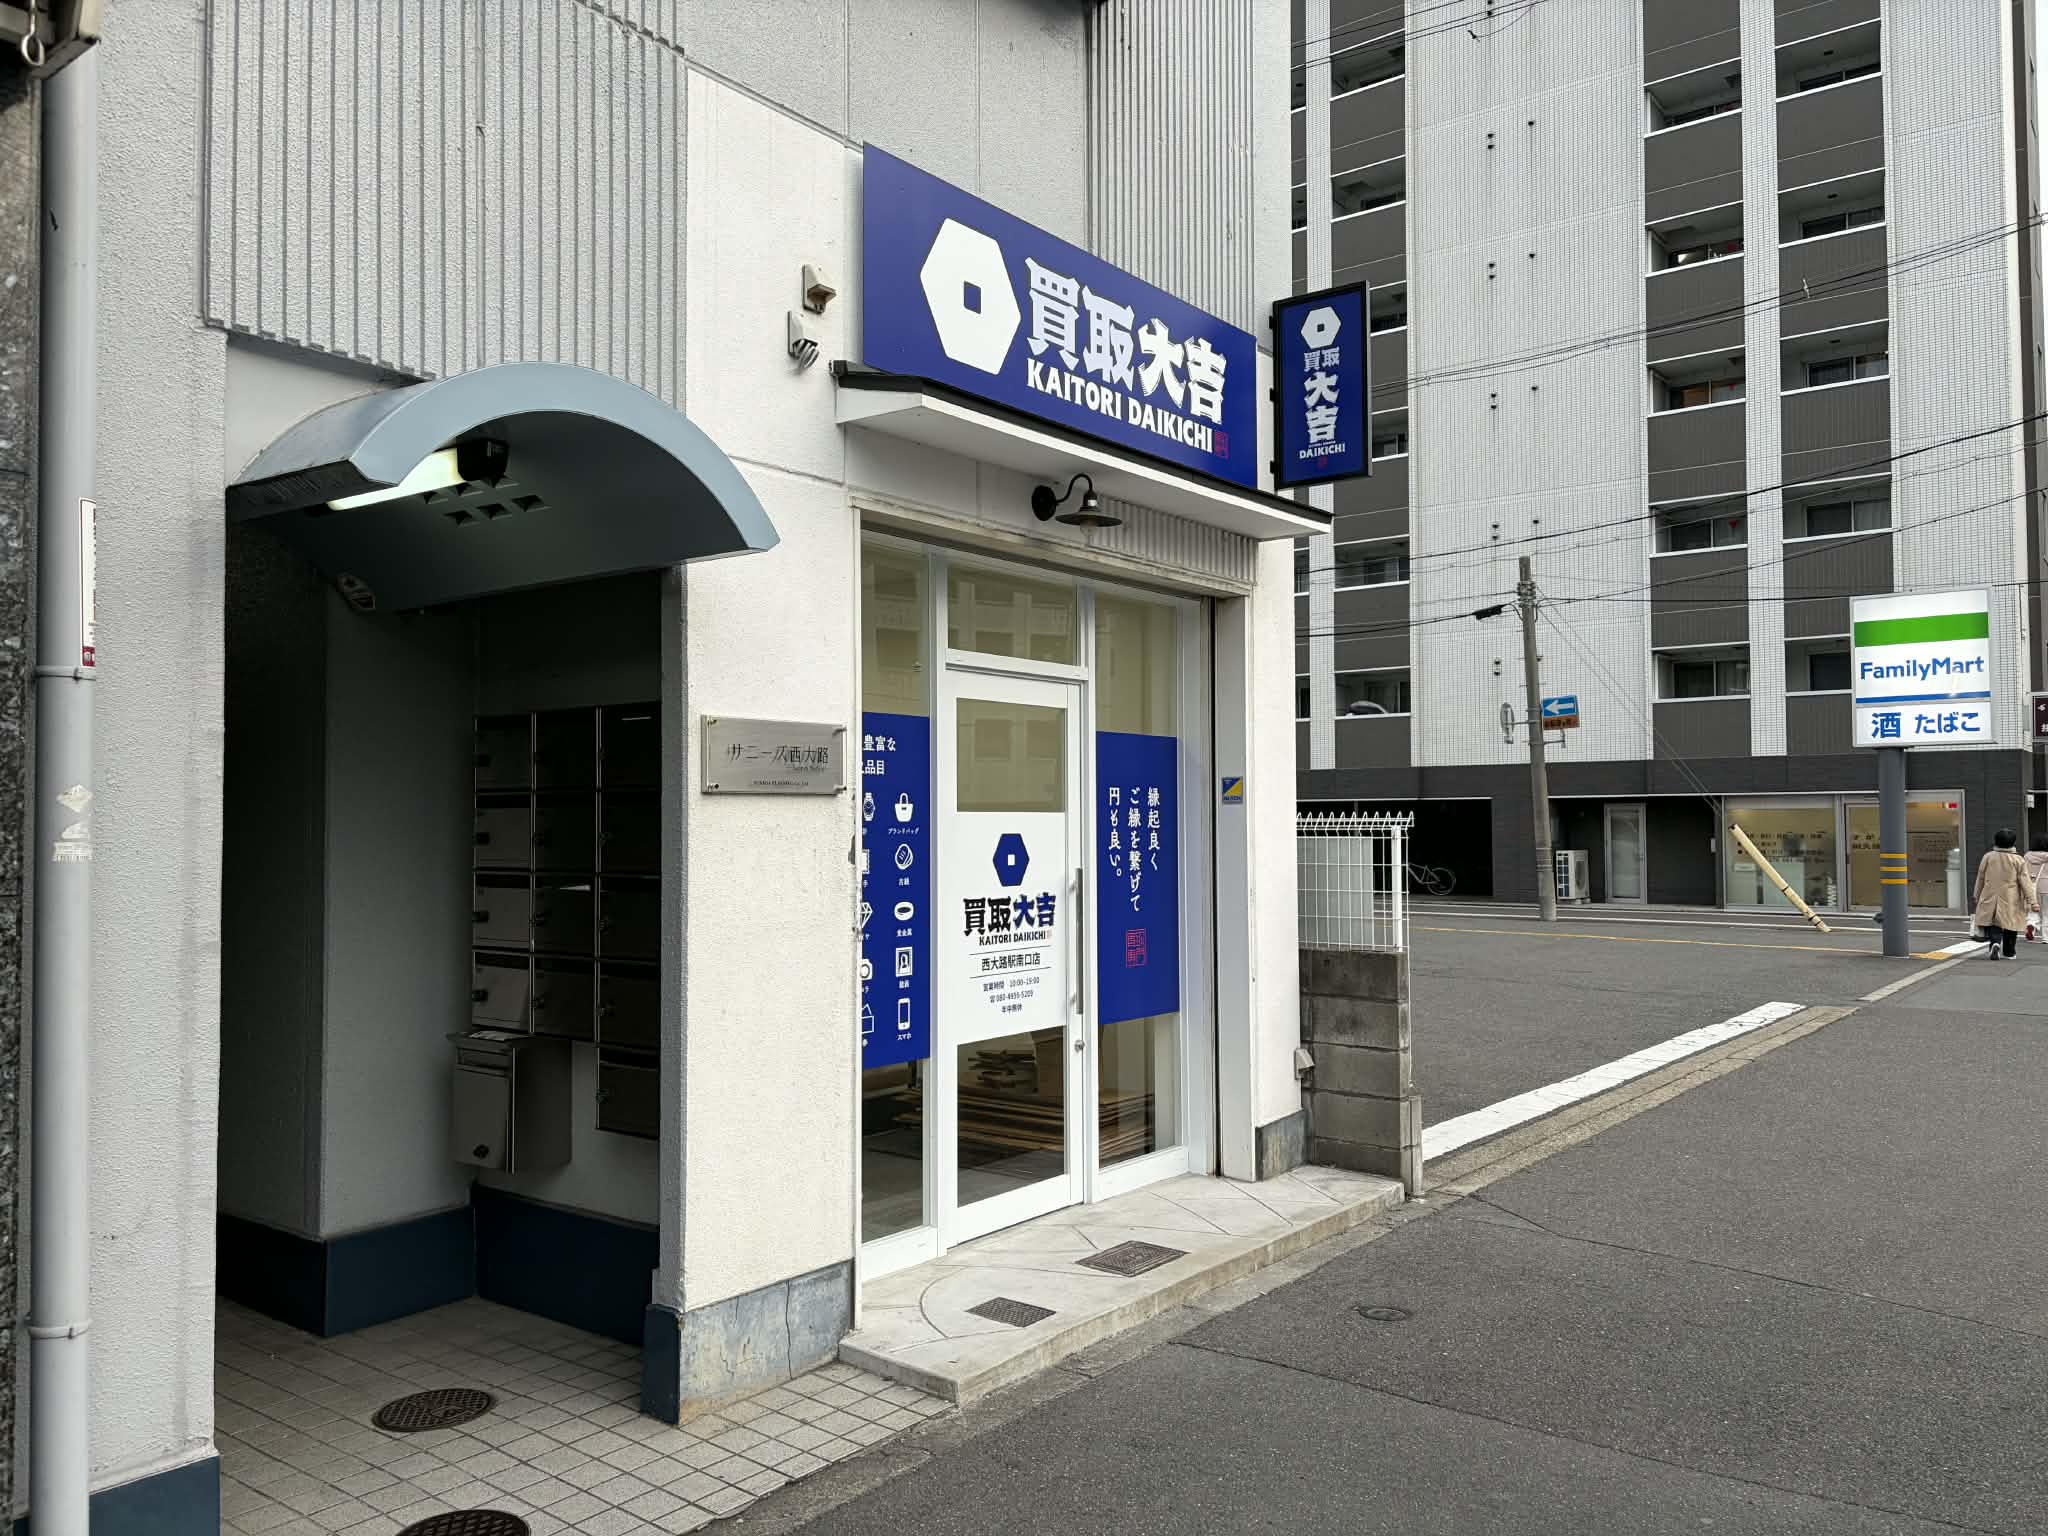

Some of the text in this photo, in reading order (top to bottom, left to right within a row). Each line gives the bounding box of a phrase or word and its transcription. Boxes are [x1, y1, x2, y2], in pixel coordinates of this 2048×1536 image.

[1025, 256, 1227, 425] 買取大吉
[1303, 346, 1340, 372] 買取
[1027, 357, 1122, 420] KAITORI
[1128, 396, 1213, 453] DAIKICHI
[1303, 371, 1340, 443] 大吉
[1299, 442, 1346, 459] DAIKICHI
[1860, 655, 1985, 681] FamilyMart
[1871, 711, 1981, 739] 酒 たばこ
[863, 734, 897, 752] 豊富な
[861, 759, 886, 776] 品目
[1147, 786, 1161, 872] 縁起良く
[1127, 786, 1142, 912] ご縁を繋げて
[963, 891, 1057, 937] 買取大吉
[979, 930, 1046, 947] KAITORI DAIKICHI
[981, 952, 1041, 972] 西大路駅南口店
